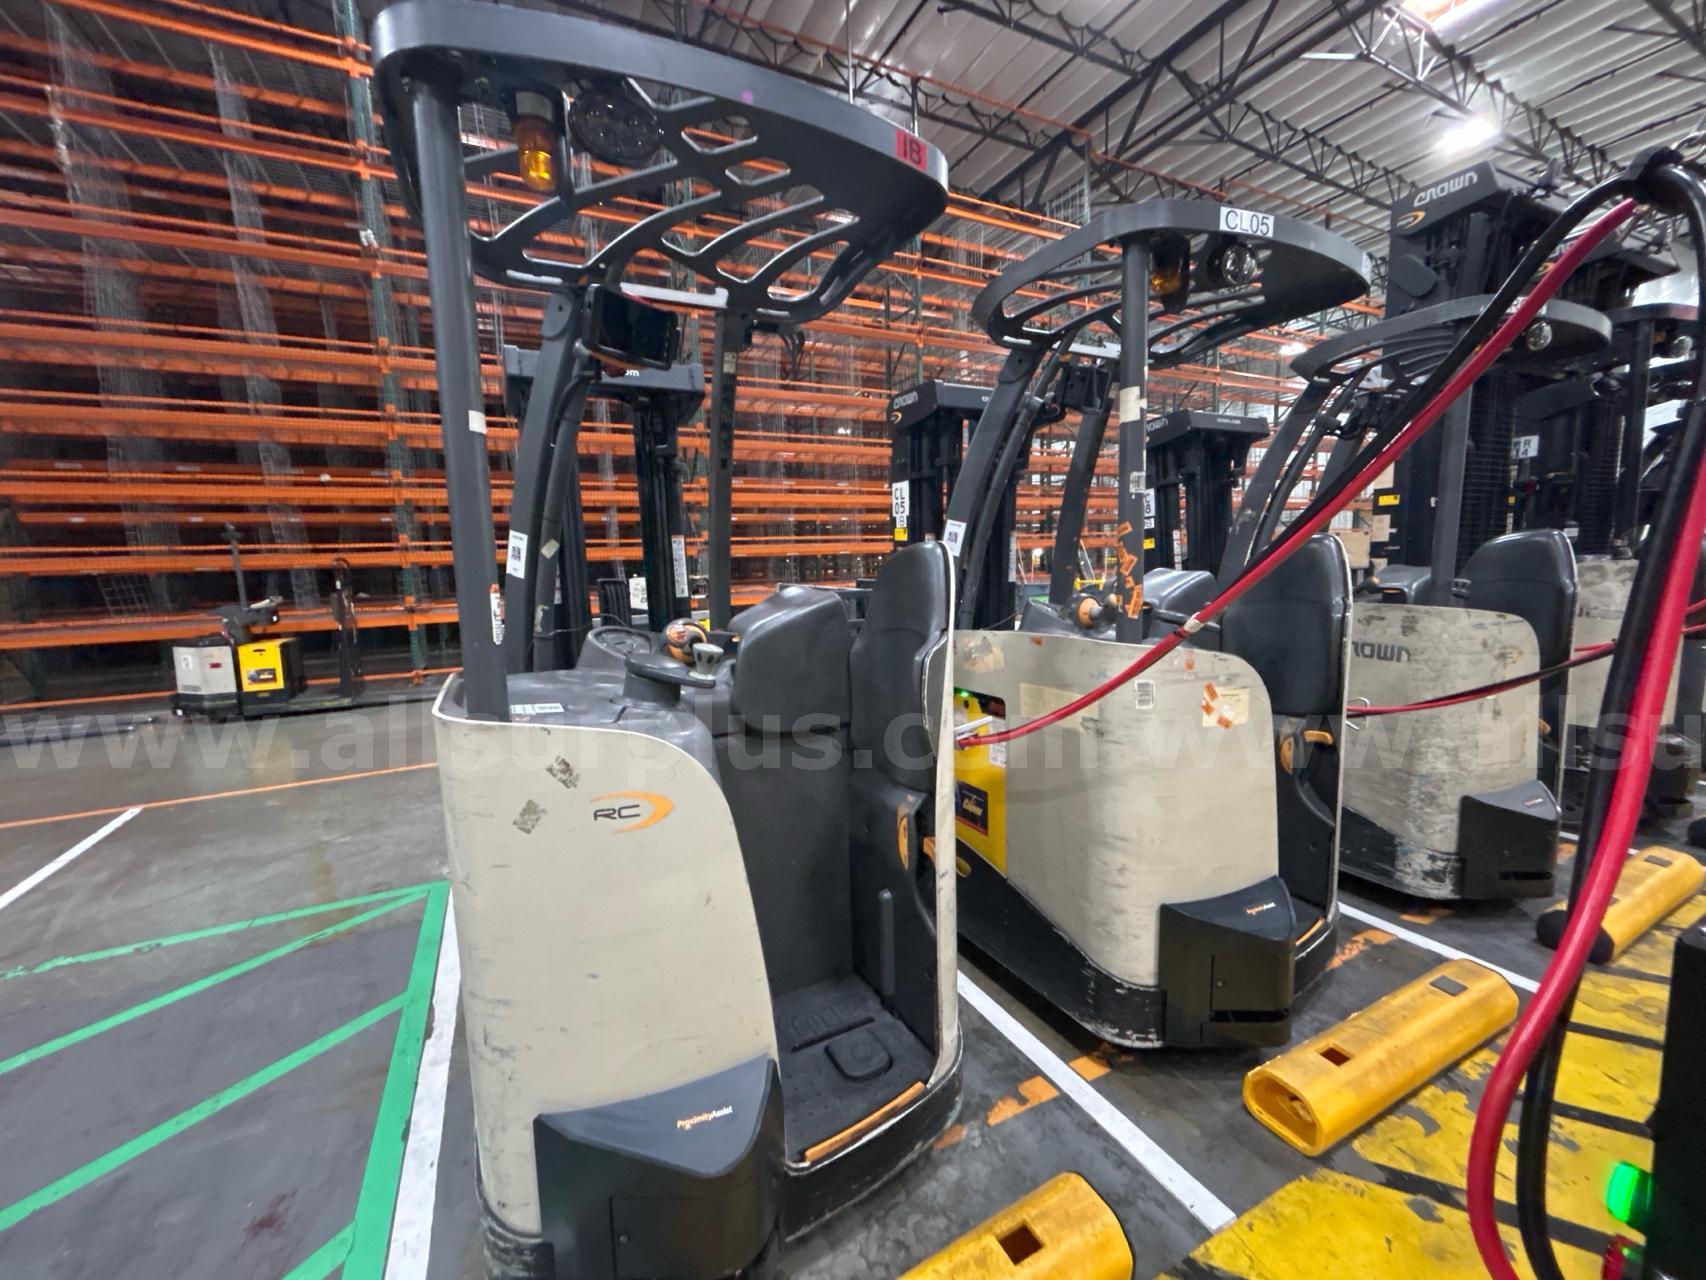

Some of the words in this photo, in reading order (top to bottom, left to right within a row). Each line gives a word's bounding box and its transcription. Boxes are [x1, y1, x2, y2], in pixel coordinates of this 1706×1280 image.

[1225, 210, 1270, 236] CL05
[894, 487, 905, 500] CL
[894, 501, 906, 515] 05
[1352, 641, 1412, 663] ROWN
[594, 804, 641, 821] RC
